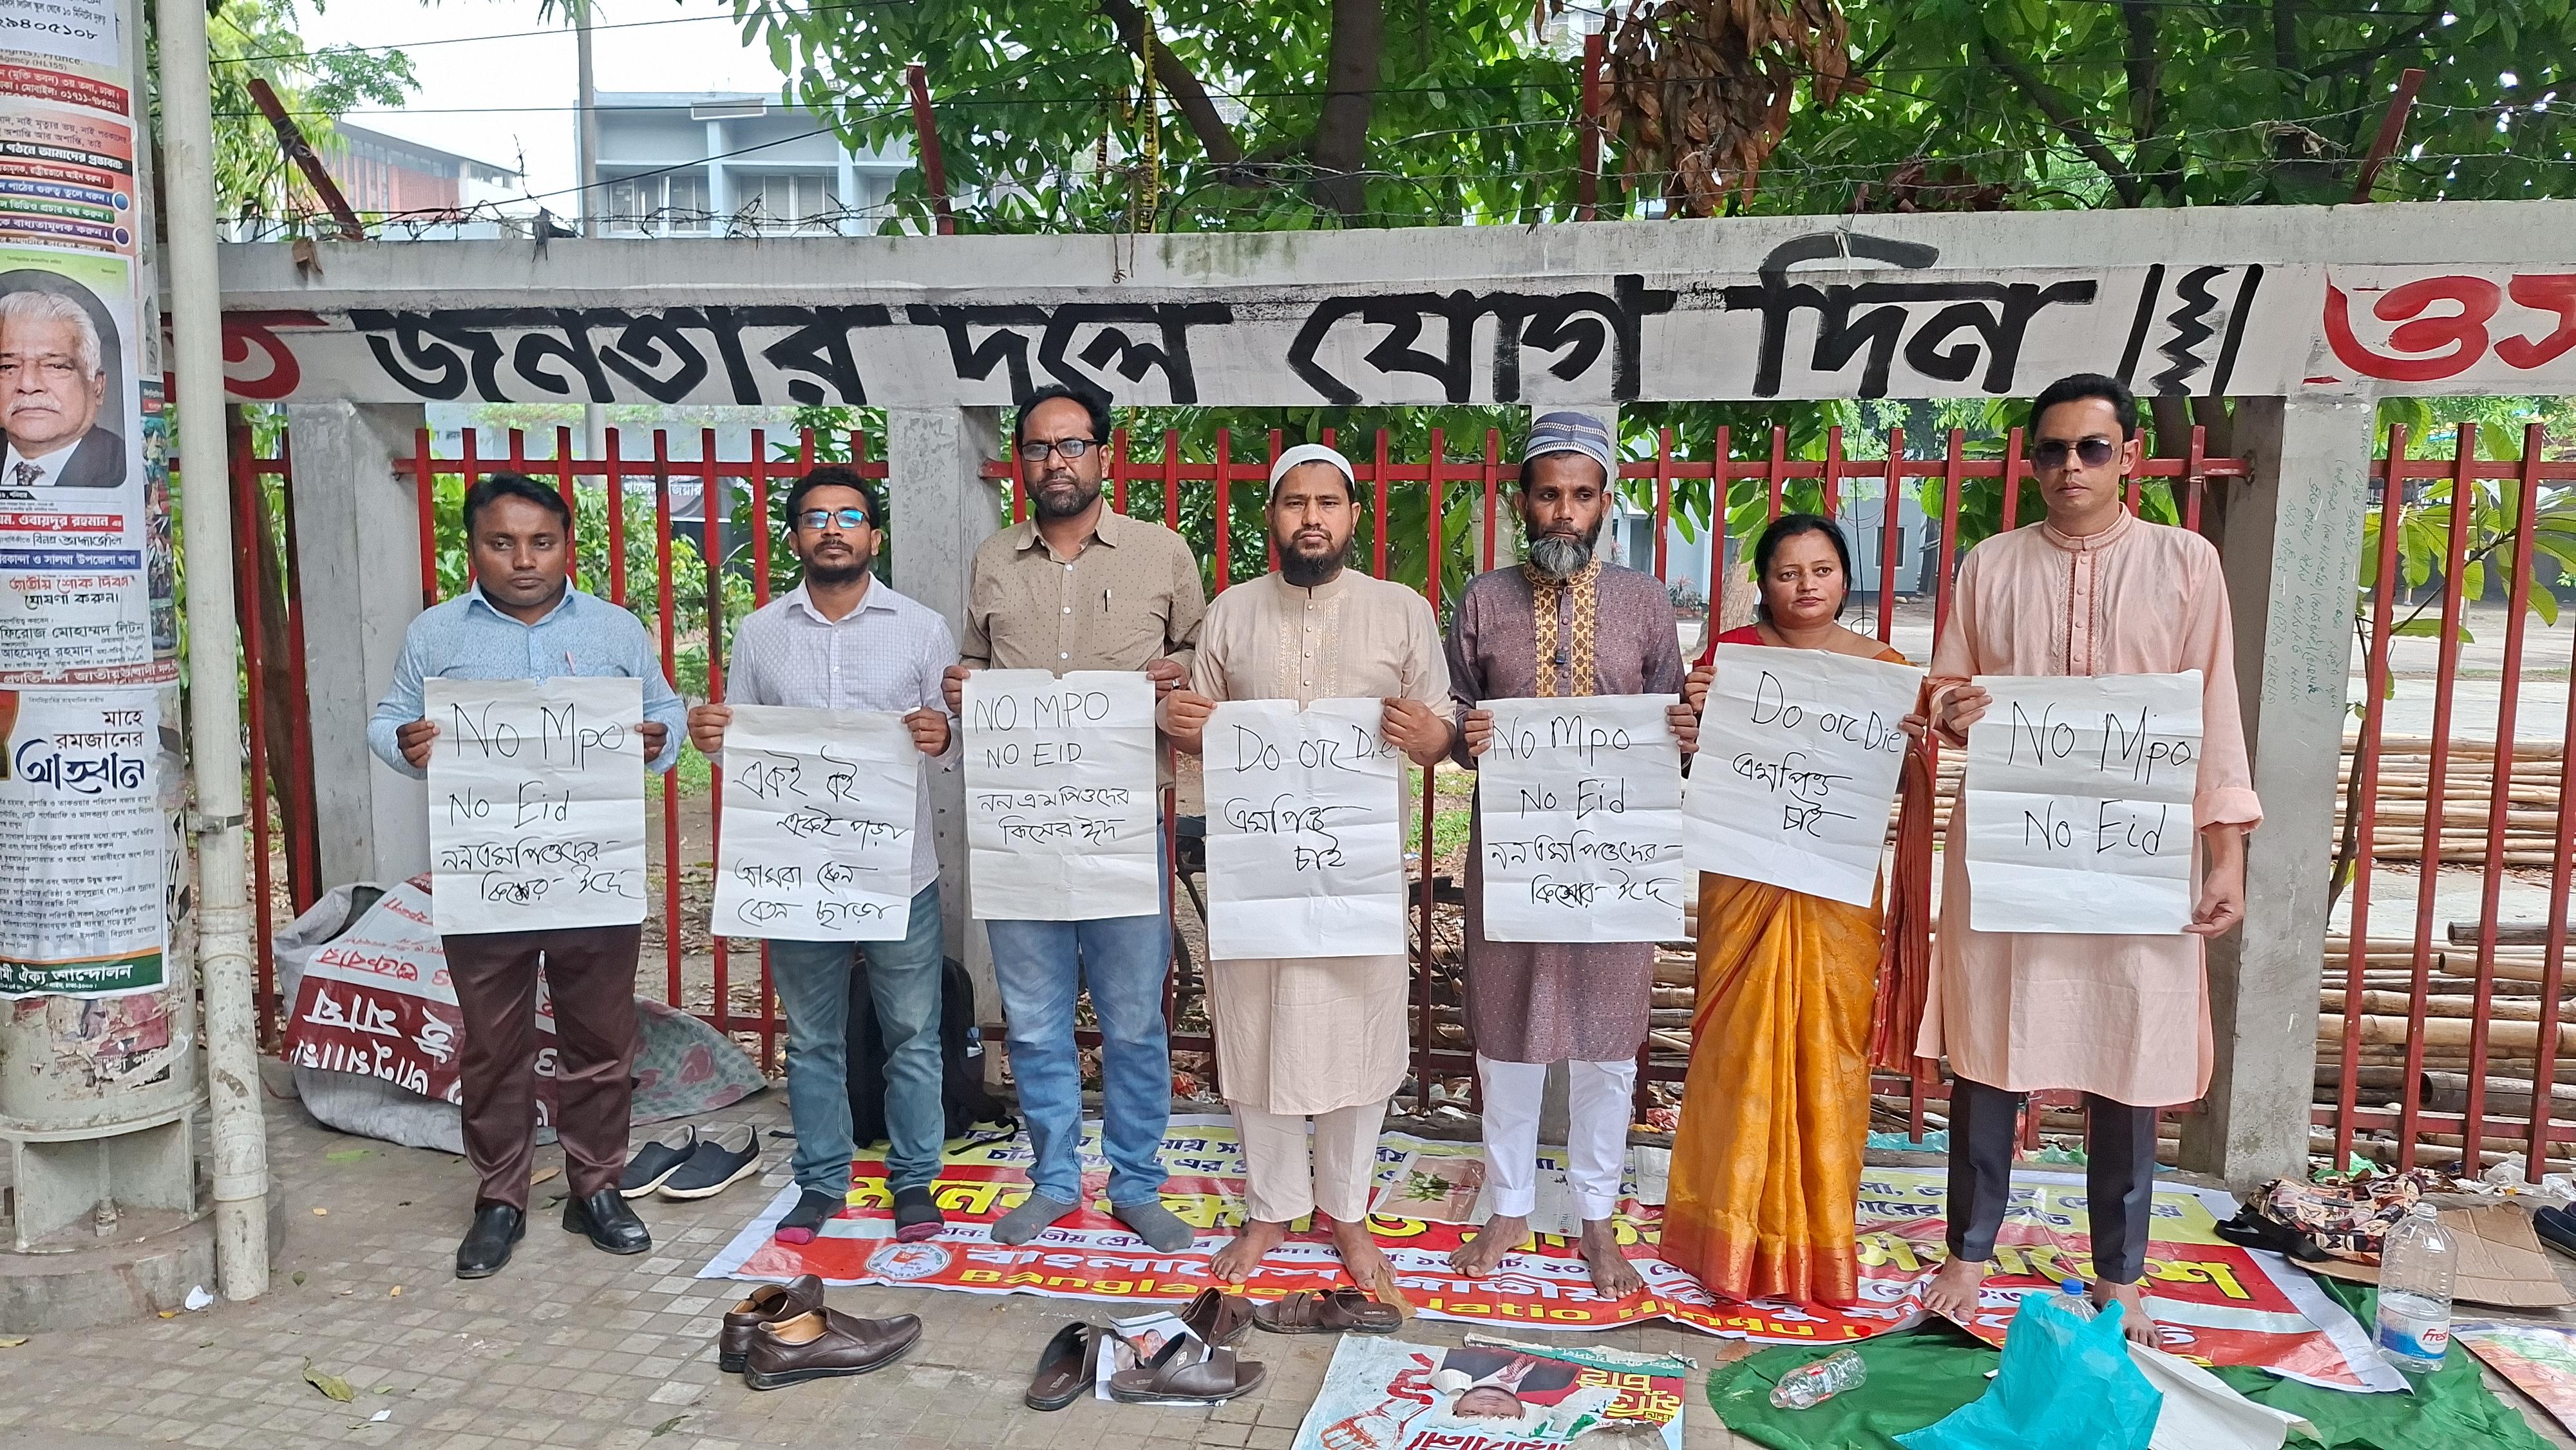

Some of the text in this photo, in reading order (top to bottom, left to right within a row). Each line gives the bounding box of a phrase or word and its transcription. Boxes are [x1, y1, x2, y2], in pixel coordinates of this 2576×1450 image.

[38, 146, 86, 162] আমাদের
[348, 232, 2098, 406] জনতার দলে যোগ দিন
[71, 516, 109, 527] রহমান
[32, 556, 41, 564] ও
[75, 552, 116, 565] উপজেলা
[25, 593, 69, 610] ঘোষণা
[57, 578, 93, 594] শোক
[0, 625, 46, 640] ফিরোজ
[52, 624, 111, 639] মোহাম্মদ
[1, 646, 93, 661] আহমেদুর রহমান
[102, 708, 144, 728] মাহে
[974, 692, 1110, 734] NO MPO
[1751, 671, 1803, 729] Do
[1864, 711, 1902, 753] Die
[53, 730, 144, 749] রমজানের
[451, 700, 520, 758] No
[1492, 716, 1535, 760] No
[2008, 701, 2076, 767] No
[987, 742, 1082, 769] NO EID
[1233, 724, 1280, 773] Do
[733, 749, 808, 800] একই
[450, 780, 569, 829] No Eid
[1520, 777, 1624, 820] No Eid
[998, 815, 1126, 846] কিসের ঈদ
[2024, 799, 2166, 856] No Eid
[735, 858, 802, 892] আমরা
[18, 964, 48, 985] ঐক্য
[316, 948, 418, 982] শুক্রবার
[302, 987, 402, 1038] মাঘ
[2422, 1328, 2447, 1341] Fres
[1575, 1368, 1652, 1391] চাই
